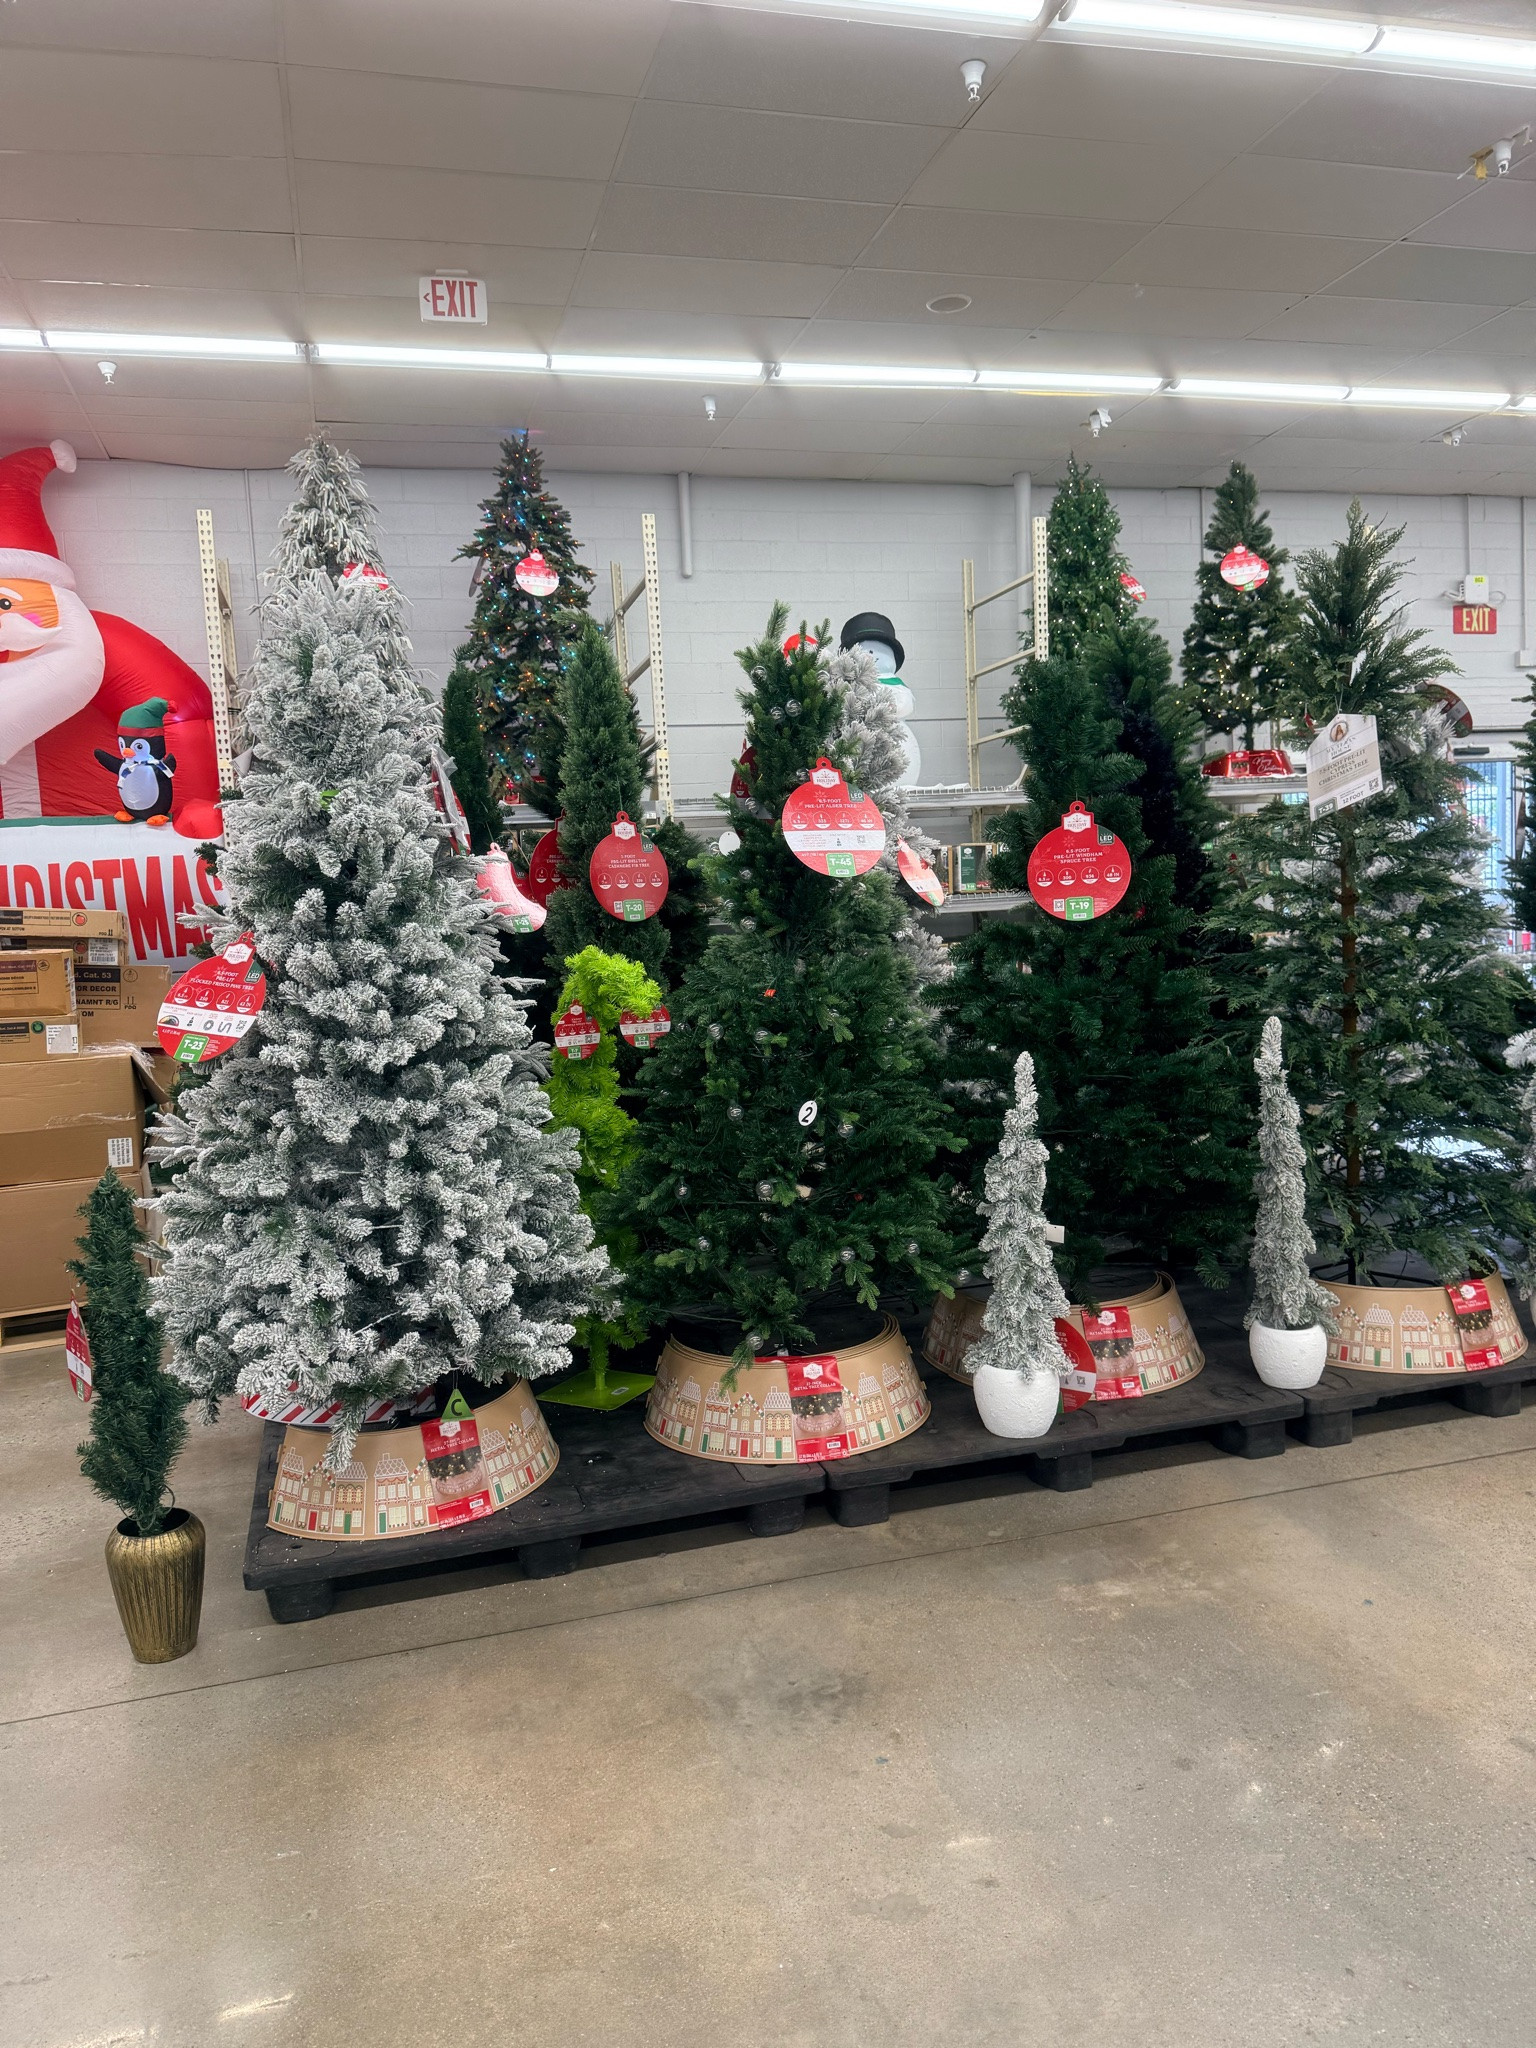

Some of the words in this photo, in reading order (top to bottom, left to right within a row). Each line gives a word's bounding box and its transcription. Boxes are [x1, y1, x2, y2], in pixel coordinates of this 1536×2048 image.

[431, 279, 477, 317] EXIT
[1462, 607, 1490, 631] EXIT
[1318, 767, 1353, 785] CHRISTMAS
[1354, 759, 1368, 769] TREE
[829, 858, 852, 866] T-45
[1069, 902, 1090, 910] T-19
[183, 1039, 204, 1050] T-23
[801, 1106, 813, 1123] 2
[450, 1398, 463, 1416] C
[430, 1445, 446, 1453] METAL
[458, 1437, 475, 1445] COLLAR
